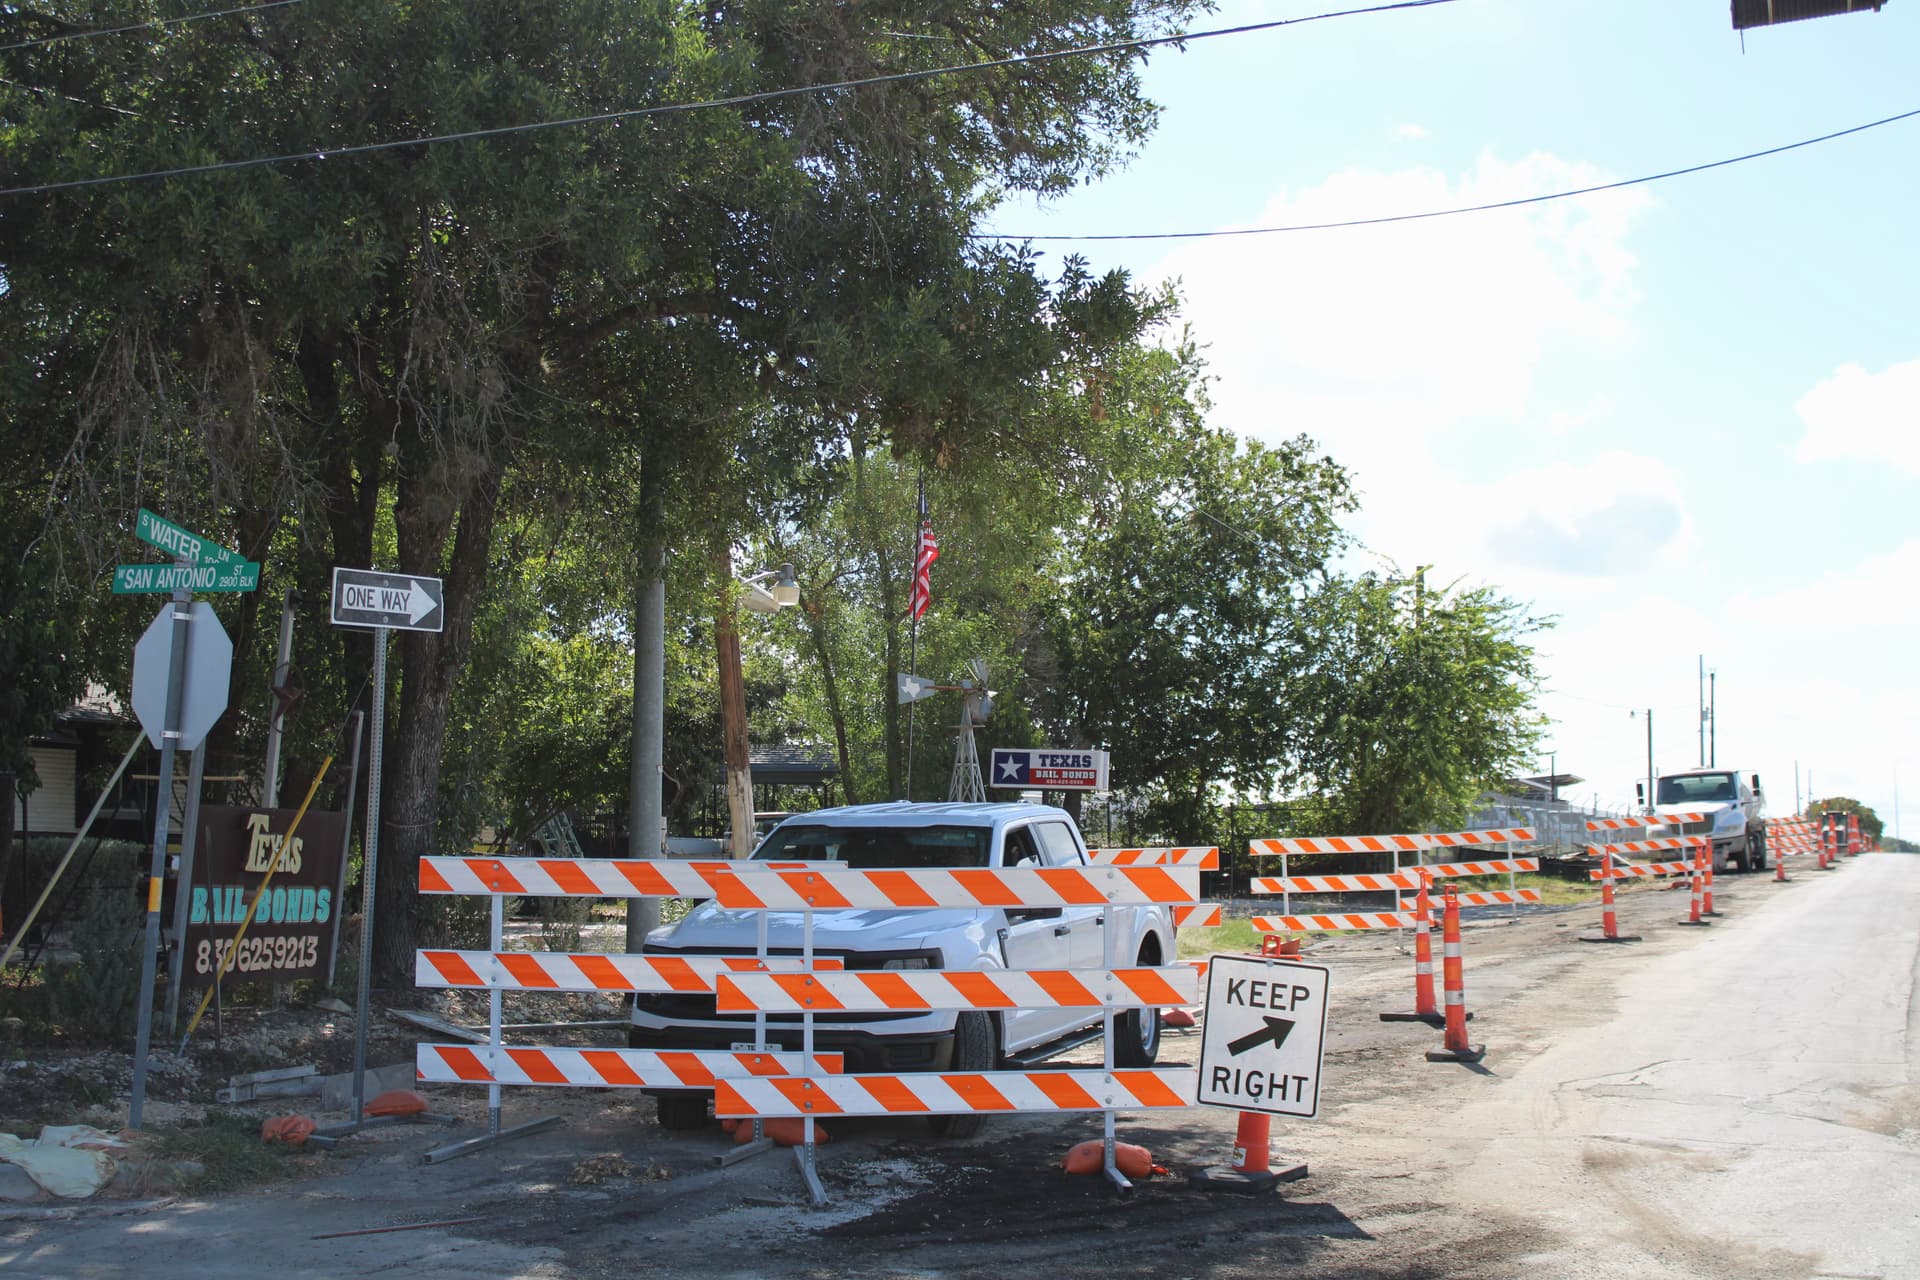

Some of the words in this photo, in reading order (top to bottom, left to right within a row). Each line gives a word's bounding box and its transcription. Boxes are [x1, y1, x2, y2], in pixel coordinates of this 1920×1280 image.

[142, 514, 149, 527] S
[150, 518, 202, 562] WATER
[218, 549, 230, 562] LN
[118, 569, 125, 579] W
[124, 568, 153, 589] SAN
[155, 567, 216, 588] ANTONIO
[233, 565, 244, 576] ST
[219, 576, 238, 587] 2900
[239, 576, 254, 587] BLK
[346, 587, 376, 608] ONE
[381, 590, 410, 612] WAY
[1035, 770, 1059, 778] BAIL
[1062, 771, 1095, 779] BONDS
[1038, 754, 1092, 768] TEXAS
[190, 886, 248, 924] BAIL
[254, 887, 331, 924] BONDS
[196, 935, 319, 975] 8306259213
[1226, 977, 1311, 1012] KEEP
[1211, 1065, 1309, 1103] RIGHT
